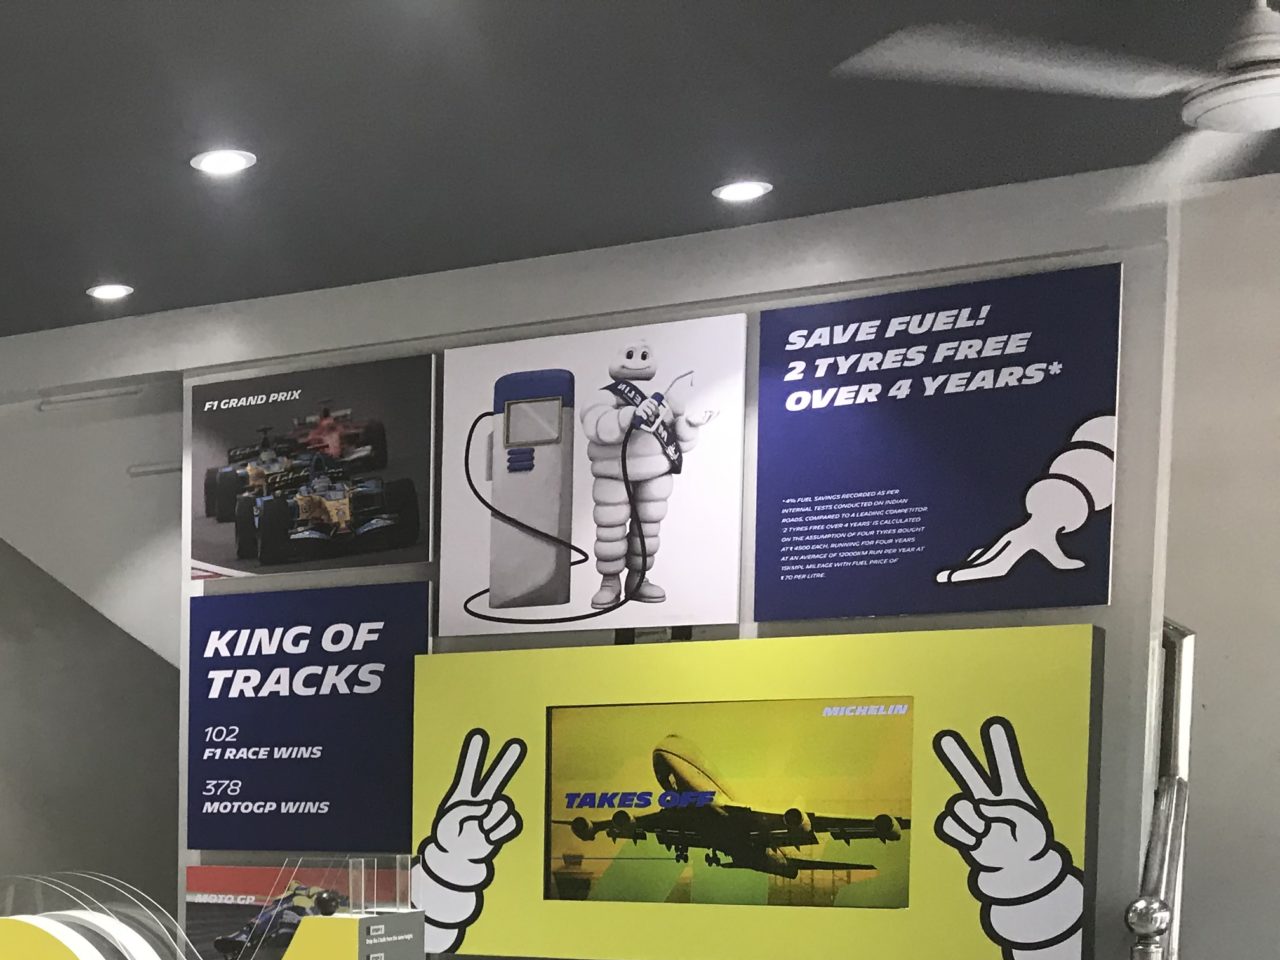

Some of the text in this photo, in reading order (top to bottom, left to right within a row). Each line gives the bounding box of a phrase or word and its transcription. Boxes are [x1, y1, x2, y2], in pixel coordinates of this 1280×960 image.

[785, 305, 991, 351] SAVE FUEL!
[784, 332, 1032, 381] 2 TYRES FREE
[204, 389, 301, 411] F1 GRAND PRIX
[785, 383, 882, 411] OVER
[887, 379, 911, 400] 4
[814, 494, 840, 502] SAVINGS
[841, 491, 876, 499] RECORDED
[834, 501, 872, 509] CONDUCTED
[805, 513, 840, 521] COMPARED
[880, 517, 921, 525] CALCULATED
[805, 532, 846, 541] ASSUMPTION
[897, 526, 925, 534] BOUGHT
[801, 552, 827, 560] AVERAGE
[203, 621, 384, 657] KING OF
[207, 663, 385, 699] TRACKS
[822, 704, 908, 717] MICHELIN
[203, 725, 239, 742] 102
[203, 745, 322, 760] F1 RACE WINS
[203, 780, 241, 797] 378
[203, 799, 329, 814] MOTOGP WINS
[564, 790, 716, 809] TAKES OFF
[195, 894, 255, 904] MOTO GP
